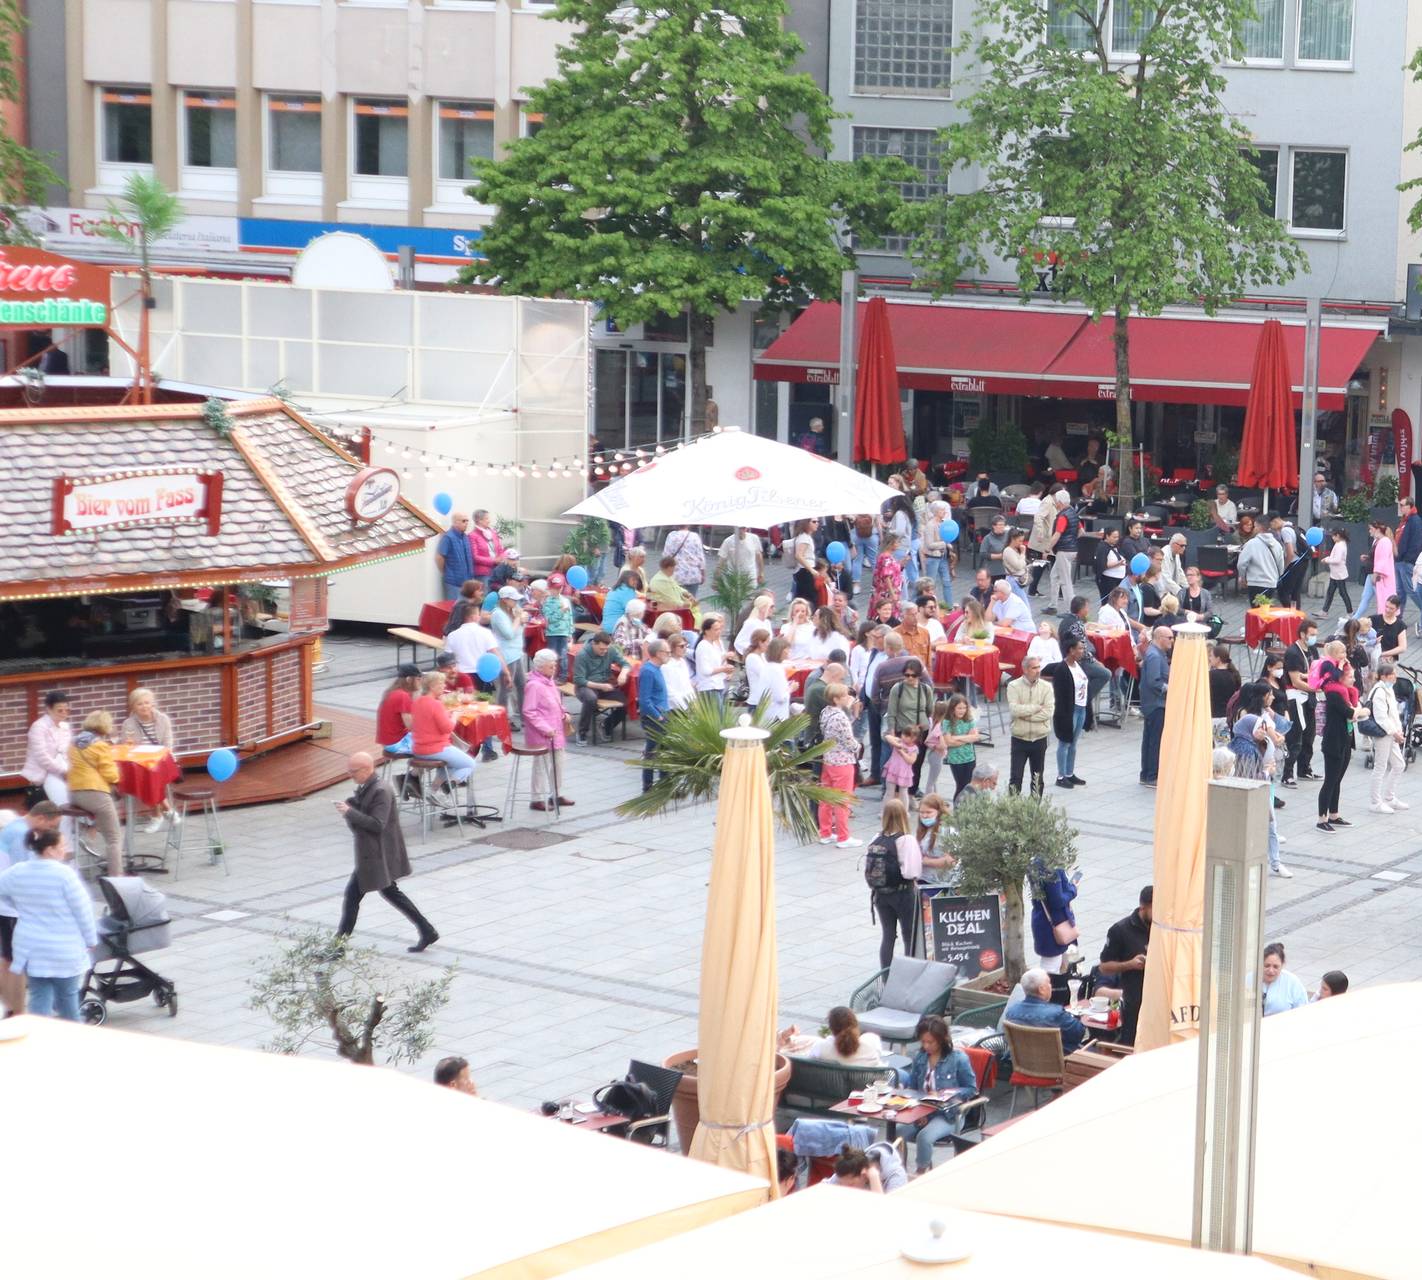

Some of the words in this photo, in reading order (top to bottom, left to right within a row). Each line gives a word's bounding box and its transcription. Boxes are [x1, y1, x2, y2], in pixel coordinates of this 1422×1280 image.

[74, 493, 111, 516] Bier
[116, 496, 150, 516] vom
[155, 487, 195, 511] Fass
[939, 909, 991, 924] KUCHEN
[946, 922, 986, 936] DEAL
